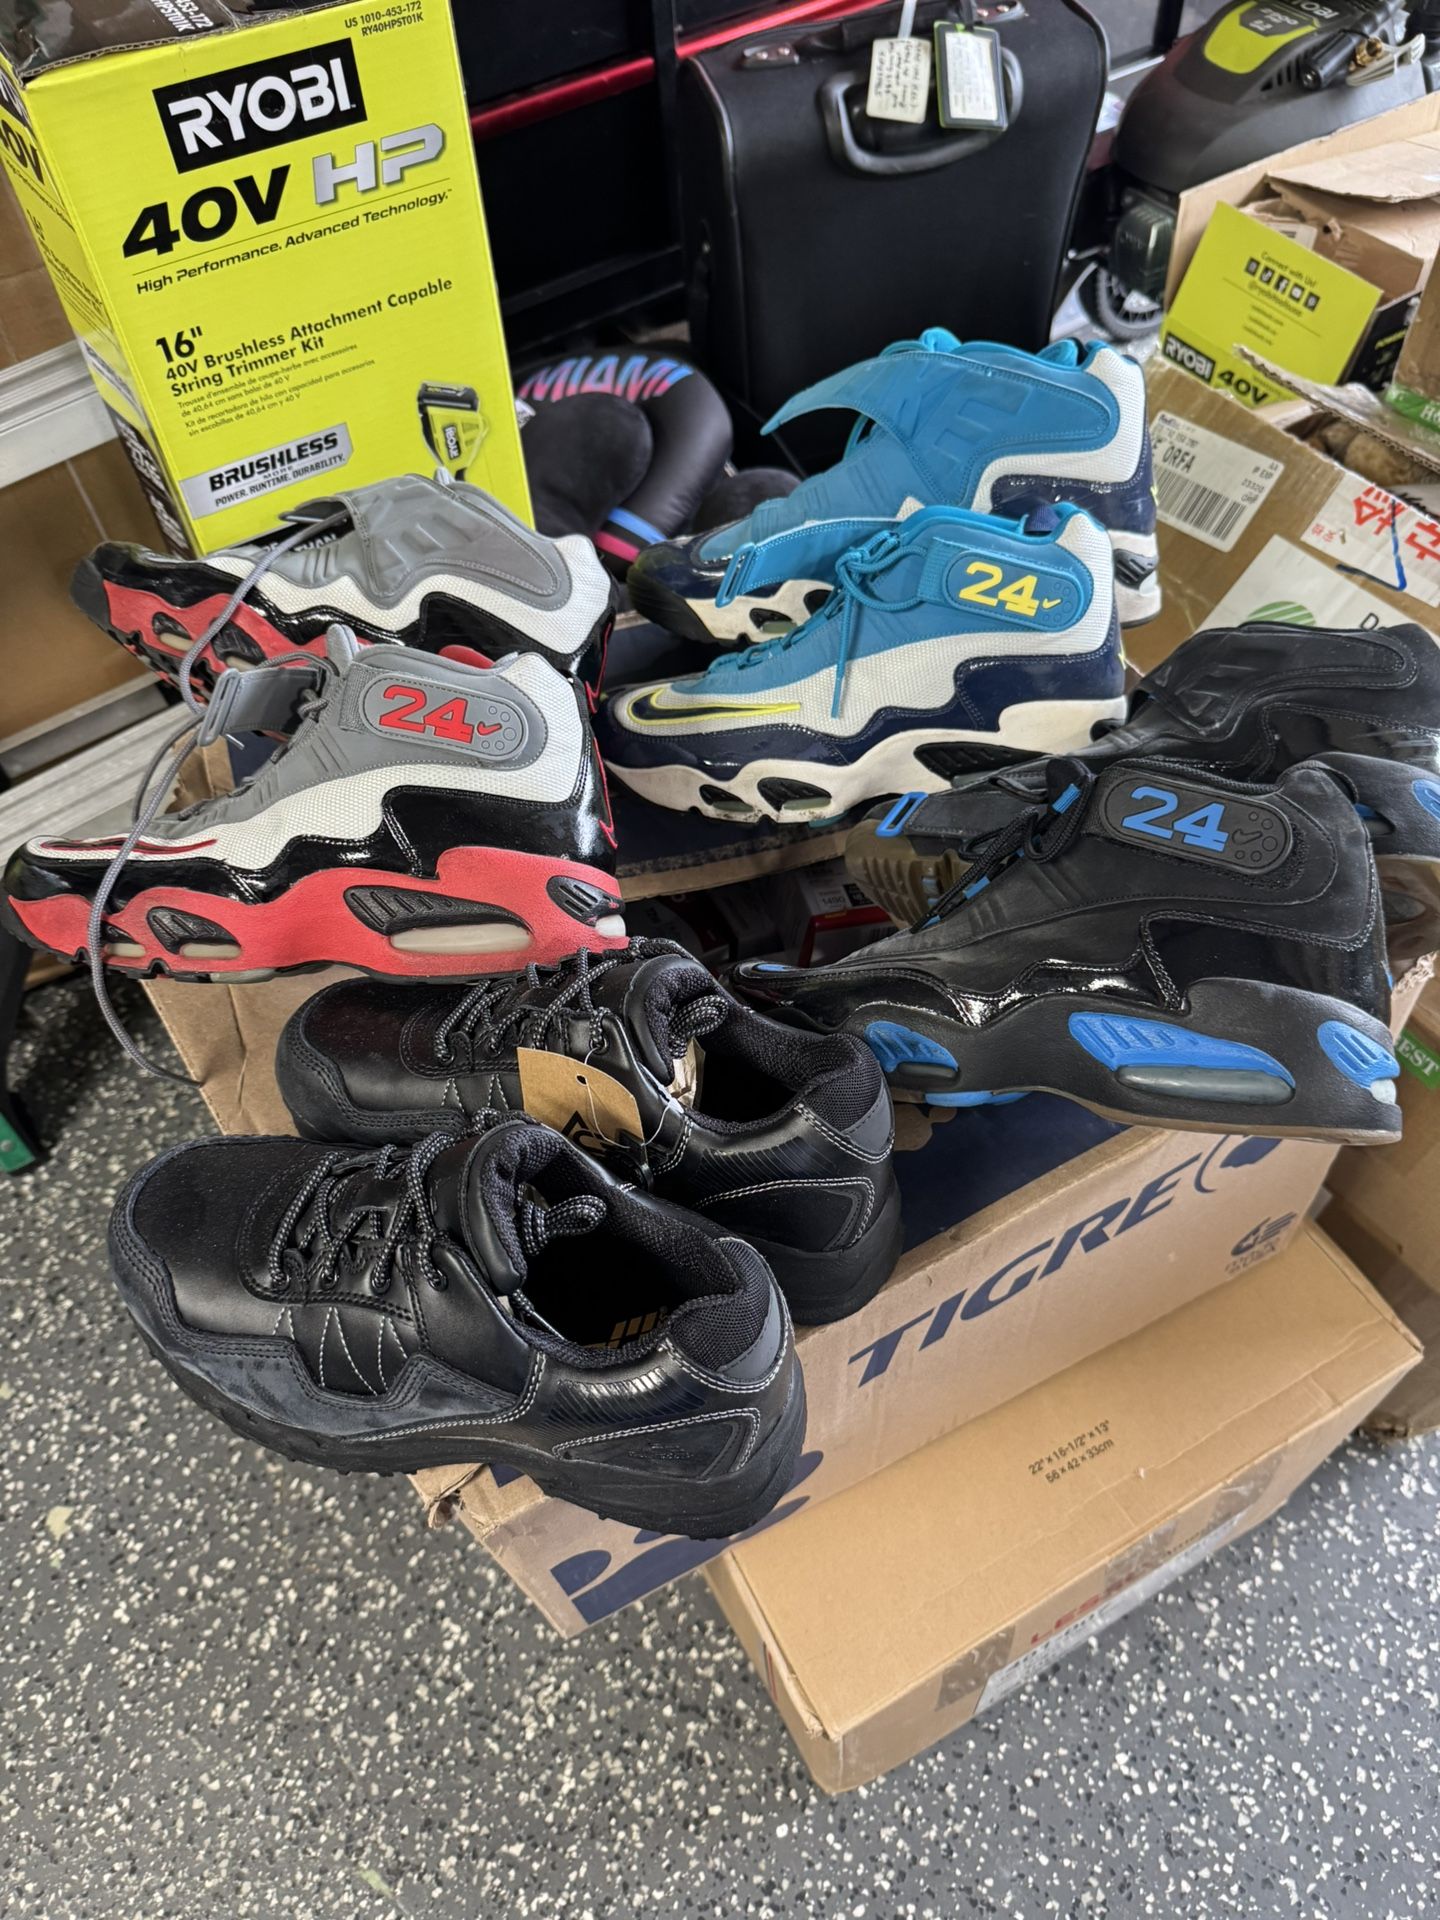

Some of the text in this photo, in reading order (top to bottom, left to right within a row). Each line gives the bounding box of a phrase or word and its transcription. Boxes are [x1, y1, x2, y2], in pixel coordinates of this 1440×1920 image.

[344, 1, 422, 29] US 1010-453-172
[361, 12, 424, 37] RY40HPST01K
[168, 57, 353, 155] RYOBI
[122, 164, 291, 259] 40V
[312, 122, 445, 206] HP
[136, 275, 173, 295] High
[176, 242, 282, 282] Performance.
[285, 215, 360, 249] Advanced
[155, 325, 203, 364] 16"
[166, 278, 453, 381] 40V Brushless Attachment Capable
[171, 335, 324, 397] String Trimmer Kit
[177, 395, 205, 408] Trousse
[247, 377, 257, 385] de
[517, 354, 695, 403] MIAMI
[1165, 334, 1213, 381] RYOBI
[1218, 370, 1269, 405] 40V
[181, 409, 191, 418] de
[215, 398, 226, 406] cm
[227, 392, 243, 402] sans
[263, 381, 272, 389] de
[274, 376, 283, 385] 40
[283, 374, 290, 382] V
[185, 419, 196, 429] Kit
[197, 416, 206, 425] de
[249, 397, 258, 406] de
[188, 428, 199, 437] sin
[235, 412, 244, 421] de
[267, 401, 278, 409] cm
[285, 394, 295, 403] 40
[208, 431, 338, 492] BRUSHLESS
[215, 453, 346, 507] POWER. RUNTIME. DURABILITY.
[263, 465, 294, 480] MORE
[958, 561, 1040, 617] 24
[379, 684, 474, 744] 24
[1121, 785, 1230, 852] 24
[847, 1152, 1203, 1389] TIGRE
[1045, 1469, 1060, 1484] 56
[1067, 1457, 1081, 1471] 42
[1086, 1438, 1115, 1459] 33cm
[1052, 1433, 1086, 1460] 16-1/2"
